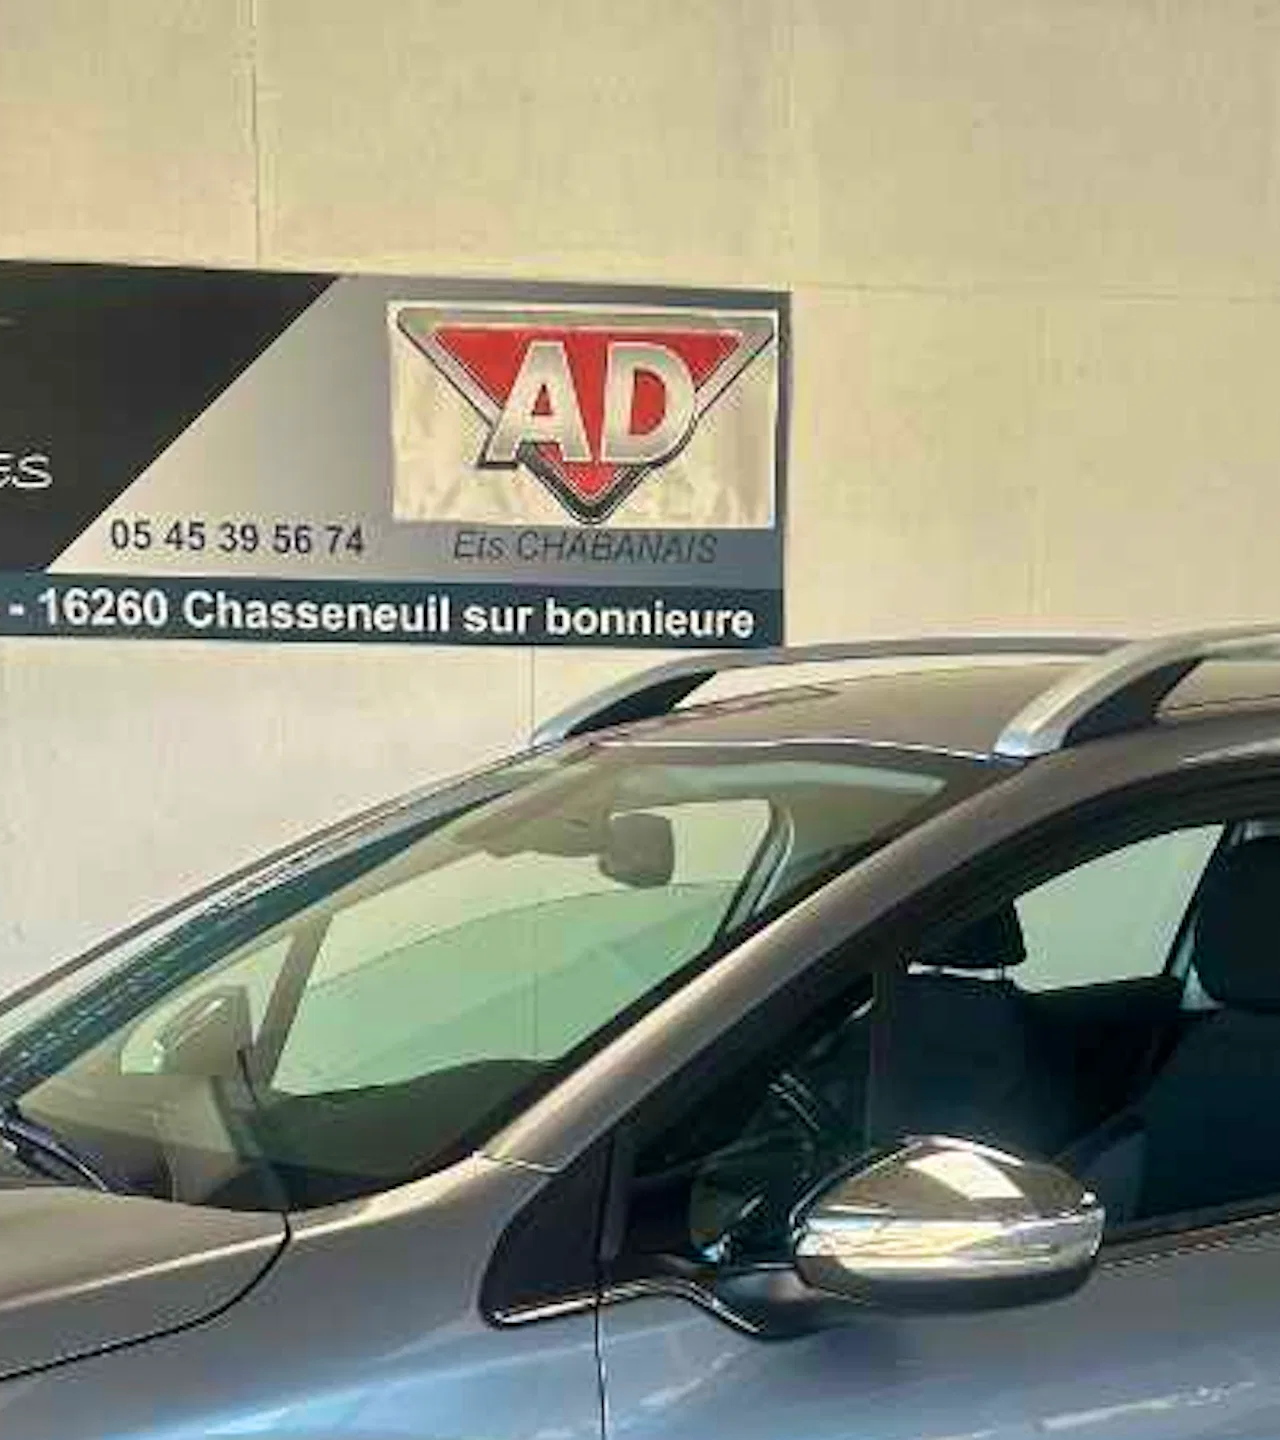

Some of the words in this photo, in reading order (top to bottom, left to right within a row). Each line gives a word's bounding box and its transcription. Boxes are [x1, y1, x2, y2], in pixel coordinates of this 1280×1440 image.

[484, 340, 698, 464] AD
[111, 519, 152, 549] 05
[164, 520, 206, 550] 45
[218, 523, 260, 553] 39
[271, 525, 313, 555] 56
[323, 527, 366, 556] 74
[517, 532, 719, 564] CHABANAIS
[42, 588, 168, 628] 16260
[183, 592, 451, 635] Chasseneuil
[465, 605, 536, 635] sur
[546, 599, 755, 638] bonnieure
